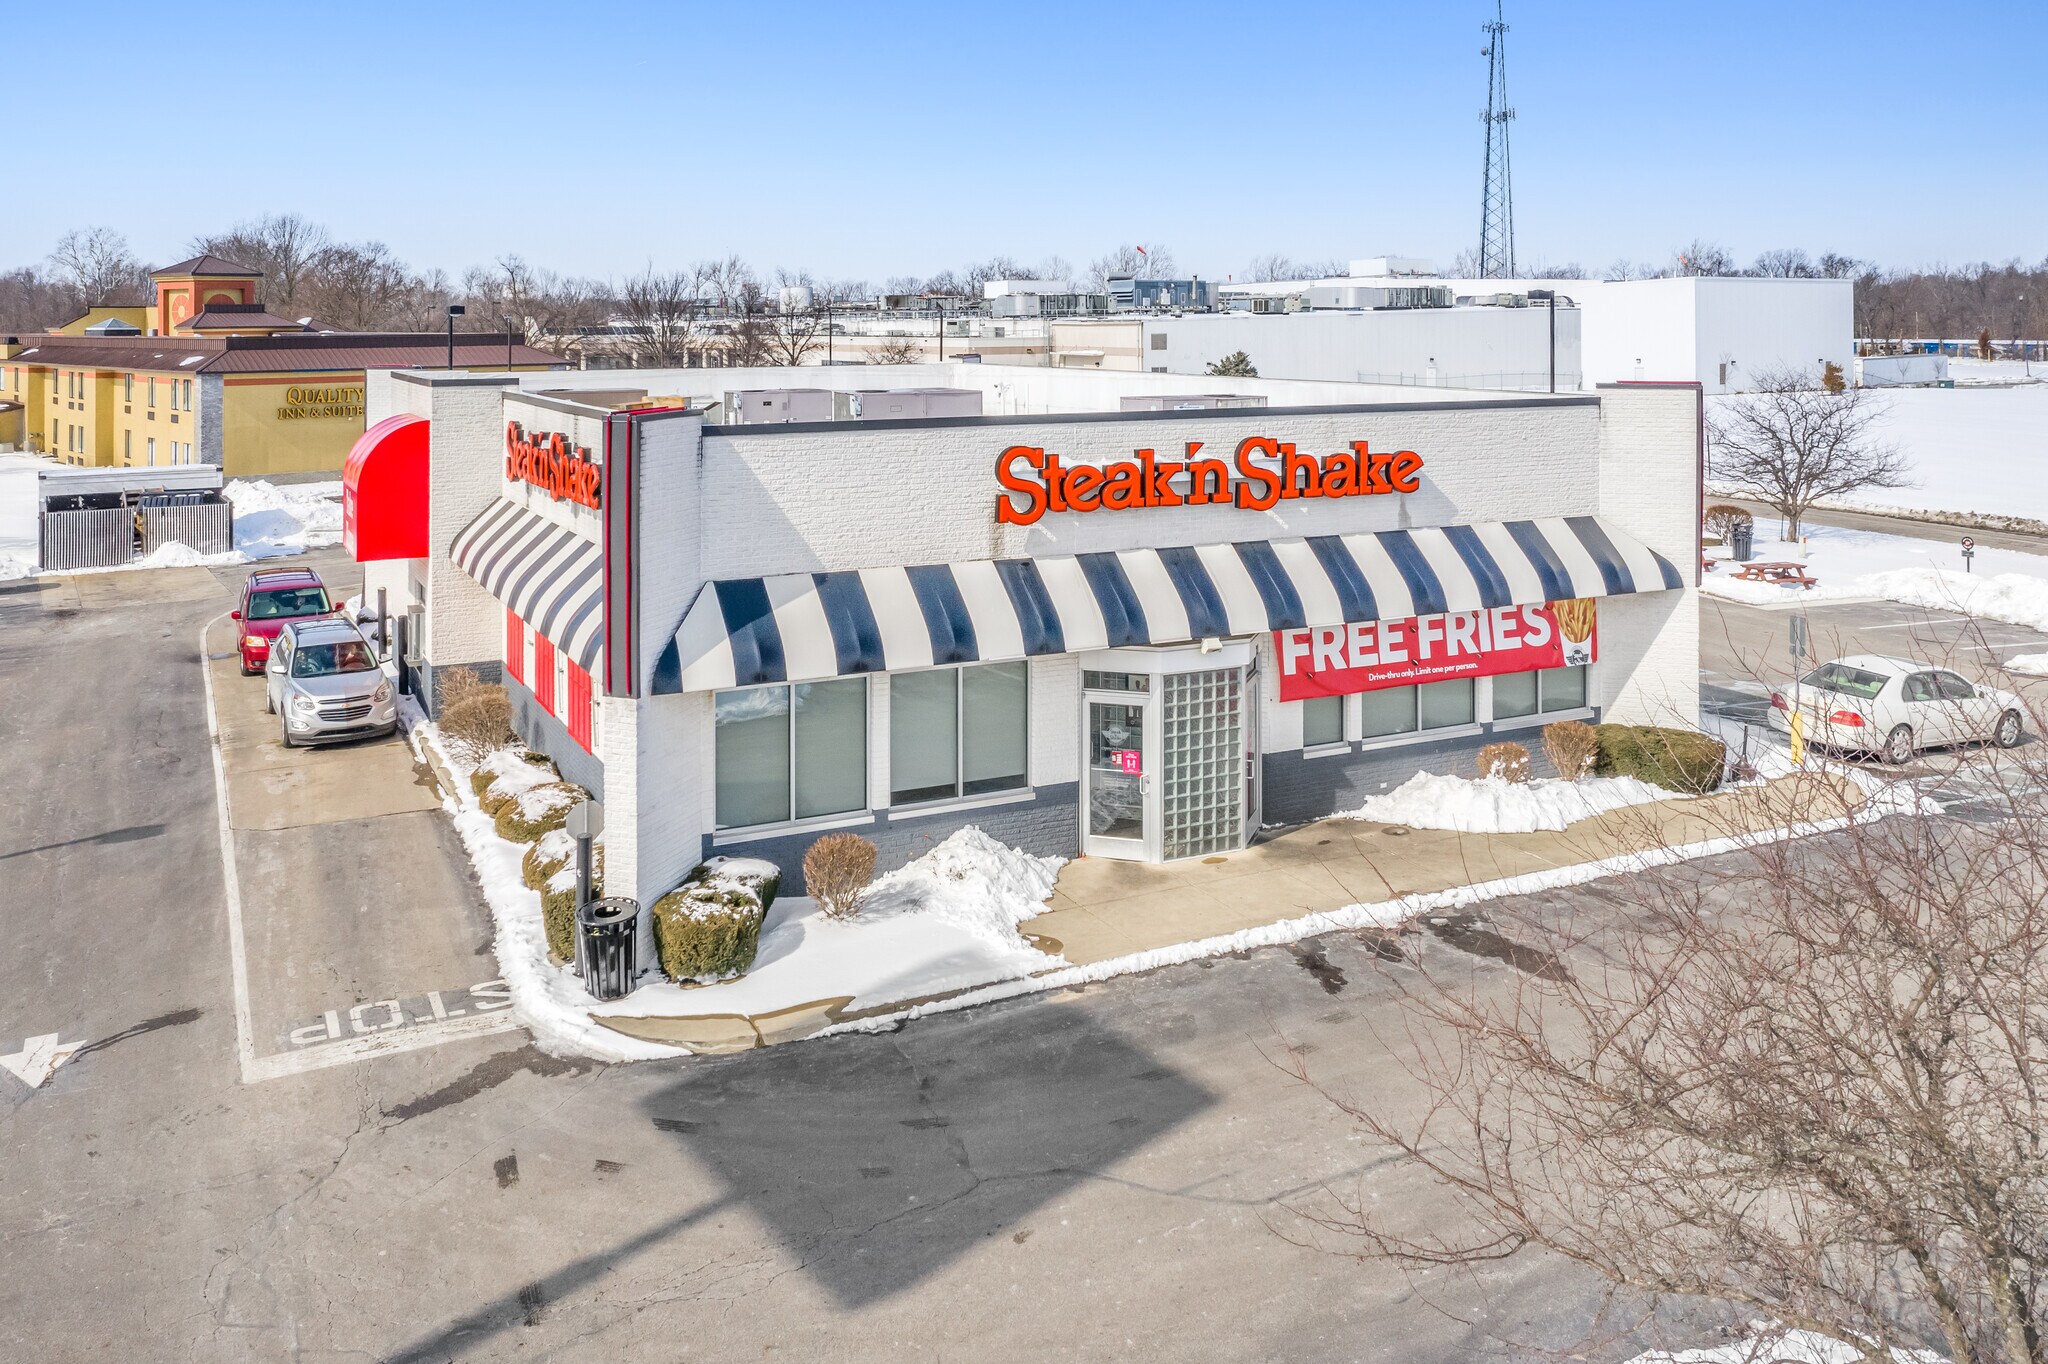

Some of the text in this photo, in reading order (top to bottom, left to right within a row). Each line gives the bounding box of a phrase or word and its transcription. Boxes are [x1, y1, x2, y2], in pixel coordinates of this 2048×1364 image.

[278, 405, 364, 420] INN & SUITE
[287, 387, 365, 406] QUALITY
[549, 432, 602, 511] Shake
[1234, 436, 1425, 511] Shake
[1282, 604, 1552, 676] FREE FRIES
[1368, 669, 1400, 681] Drive-thru
[1401, 668, 1415, 678] only.
[1415, 666, 1431, 676] Limit
[1445, 665, 1455, 674] per
[1456, 663, 1478, 672] person.
[290, 979, 515, 1044] STOP
